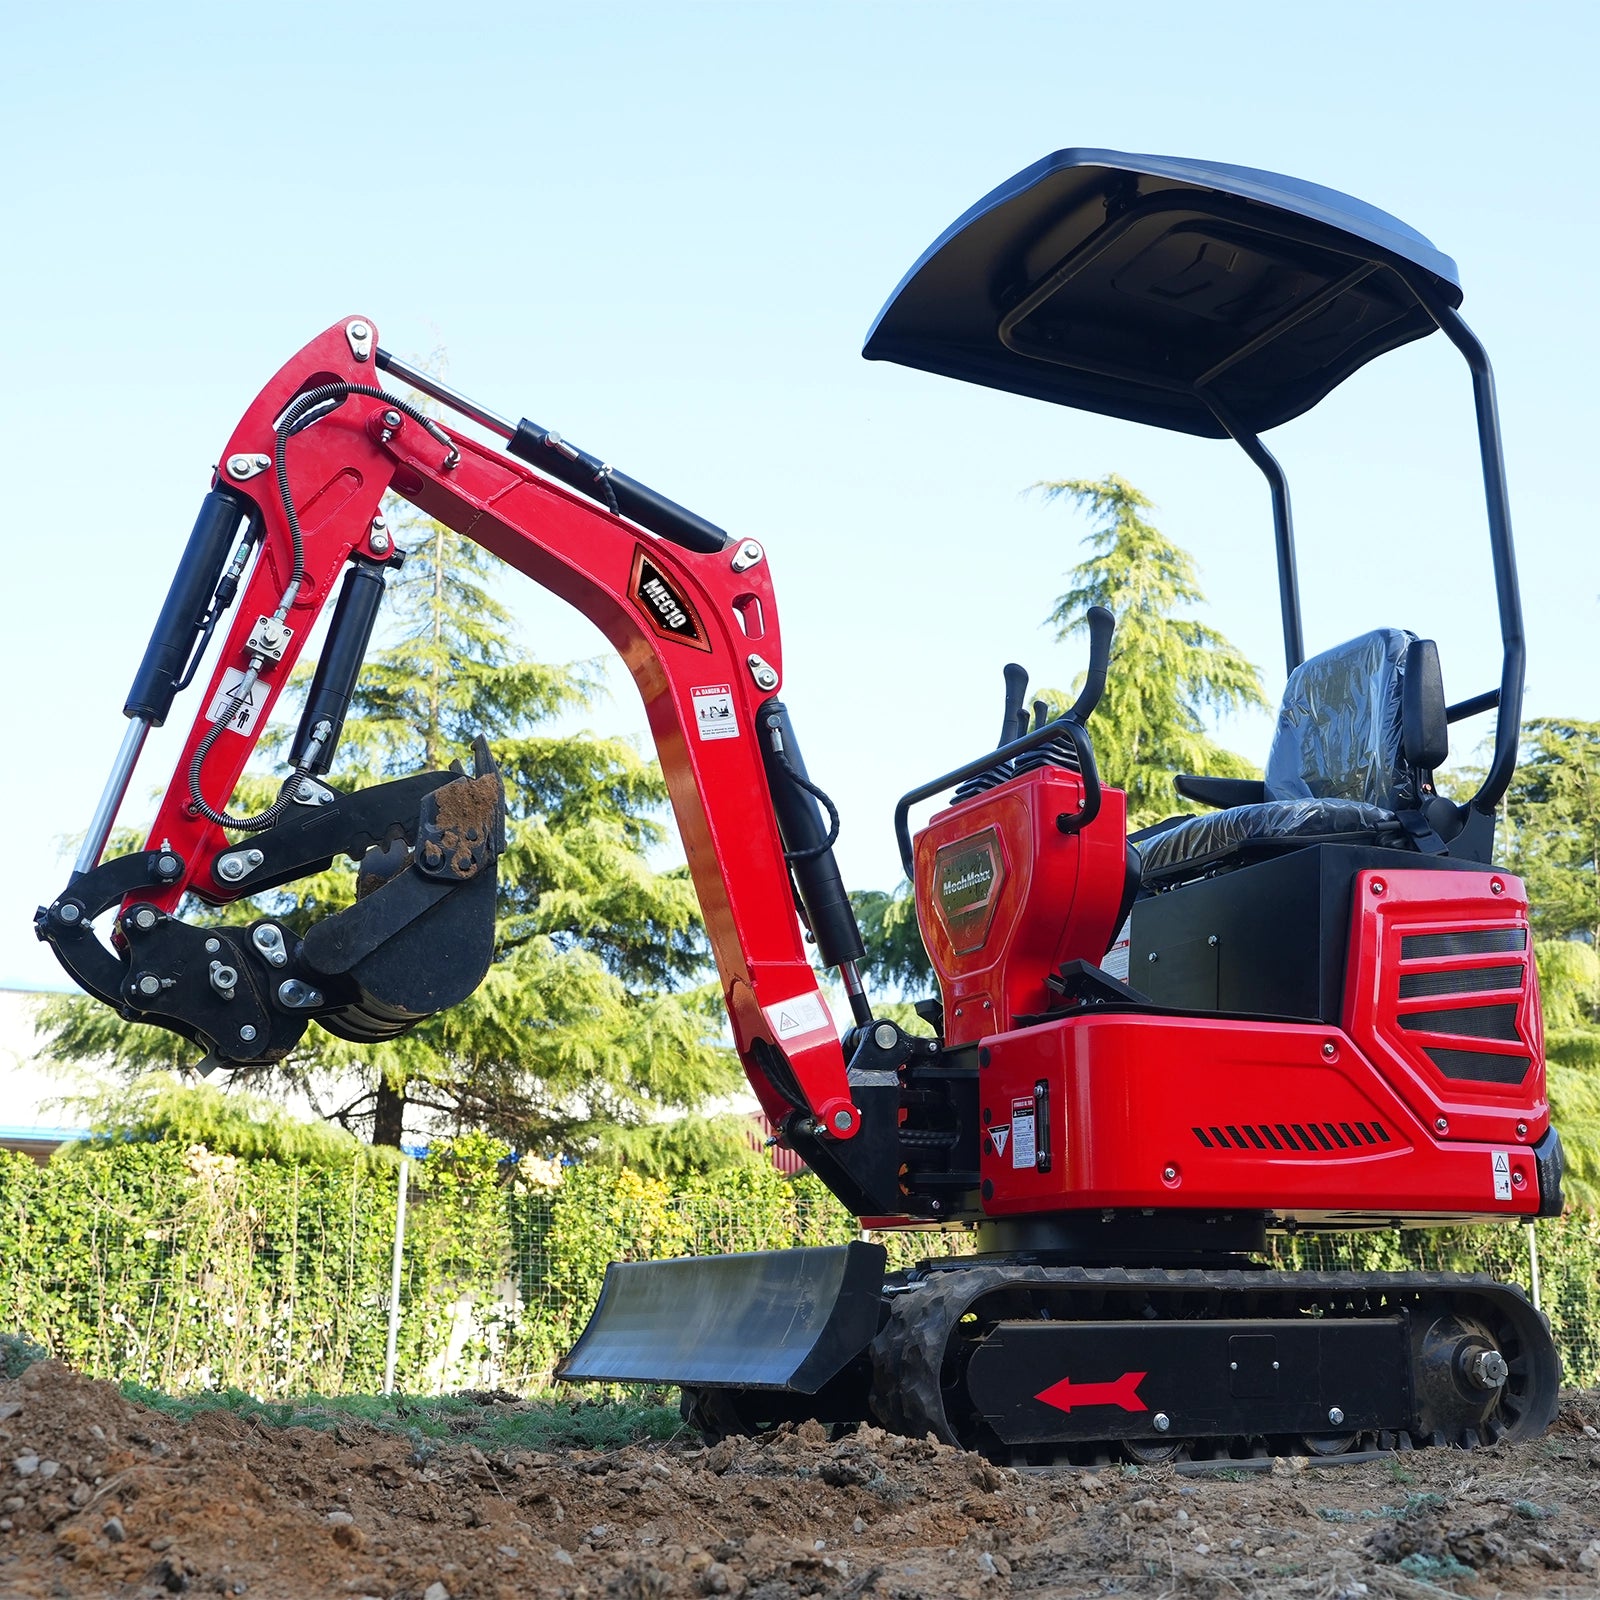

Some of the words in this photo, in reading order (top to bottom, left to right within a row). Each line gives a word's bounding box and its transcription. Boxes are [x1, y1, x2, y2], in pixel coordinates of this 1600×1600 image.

[642, 577, 687, 629] MEC10
[701, 687, 721, 695] DANGER
[943, 869, 991, 896] MechMaxx
